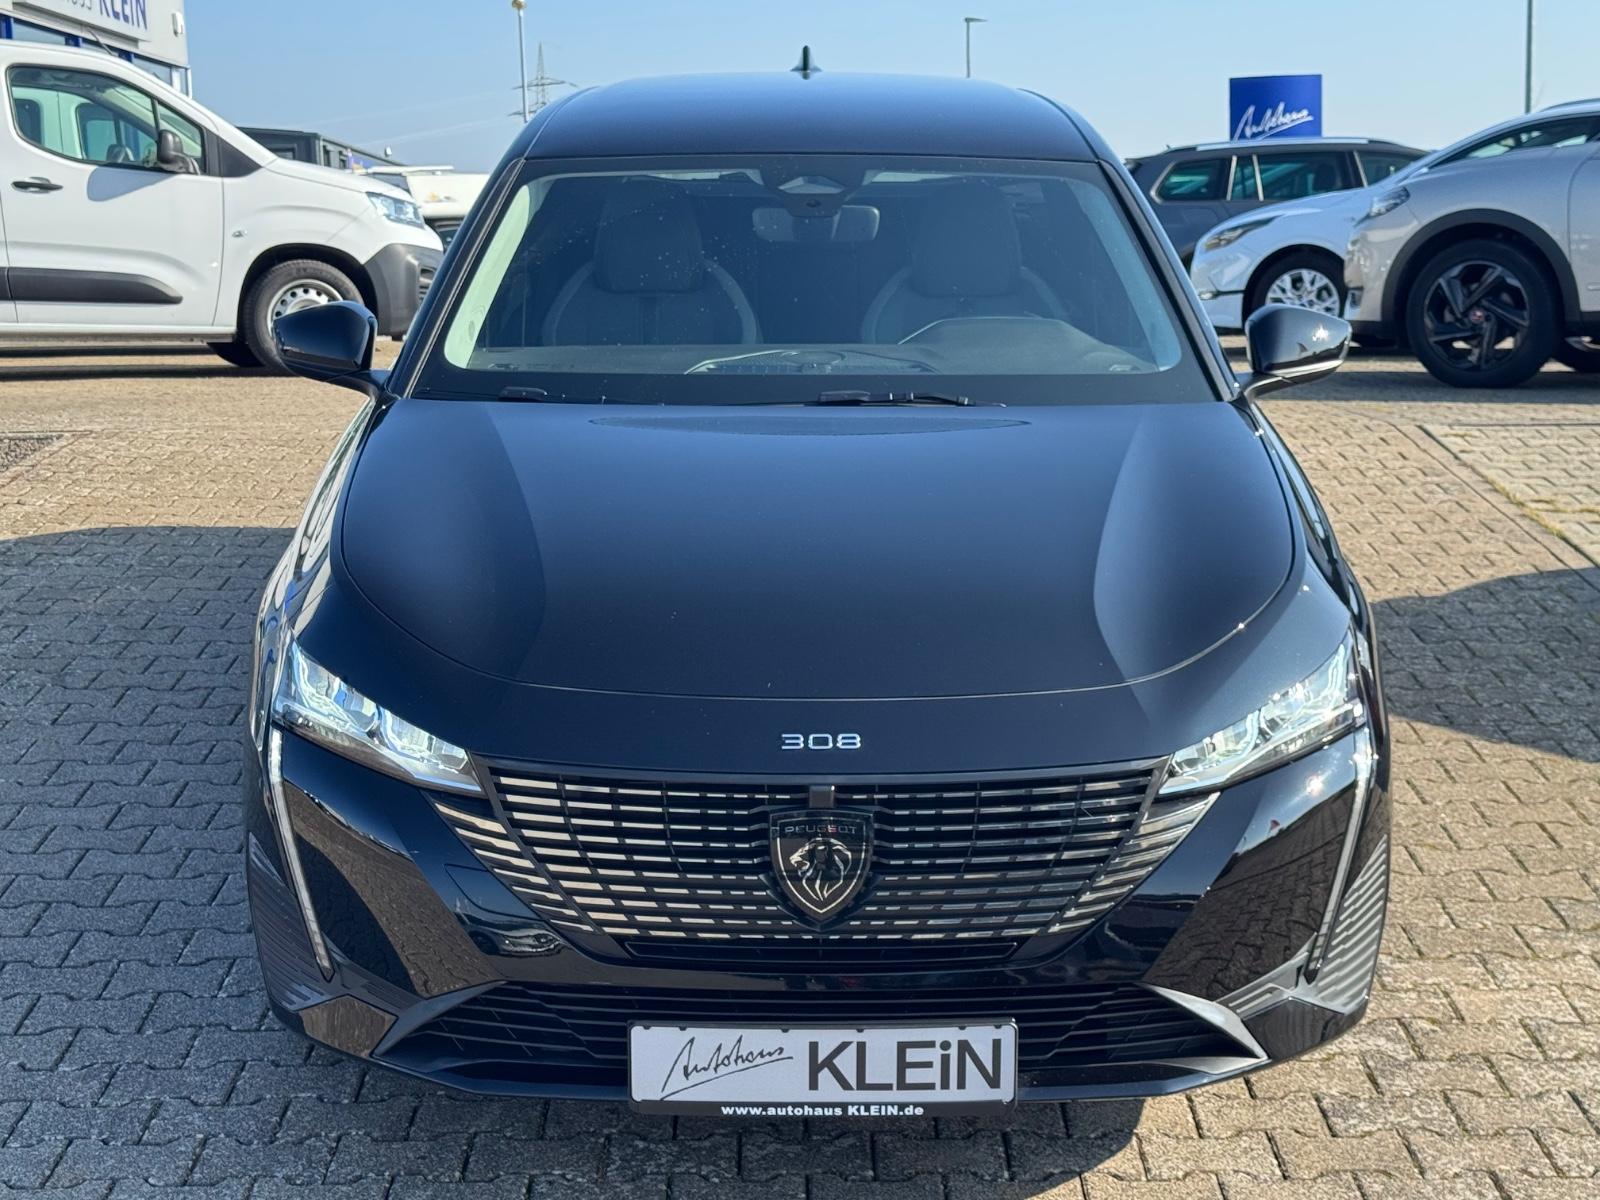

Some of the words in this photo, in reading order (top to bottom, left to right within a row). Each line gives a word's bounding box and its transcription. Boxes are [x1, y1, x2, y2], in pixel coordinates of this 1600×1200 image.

[781, 733, 862, 750] 308
[784, 824, 857, 834] PEUGEOT
[661, 1034, 786, 1094] Autohaus
[721, 1105, 843, 1117] www.autohaus
[847, 1104, 925, 1116] KLEIN.de
